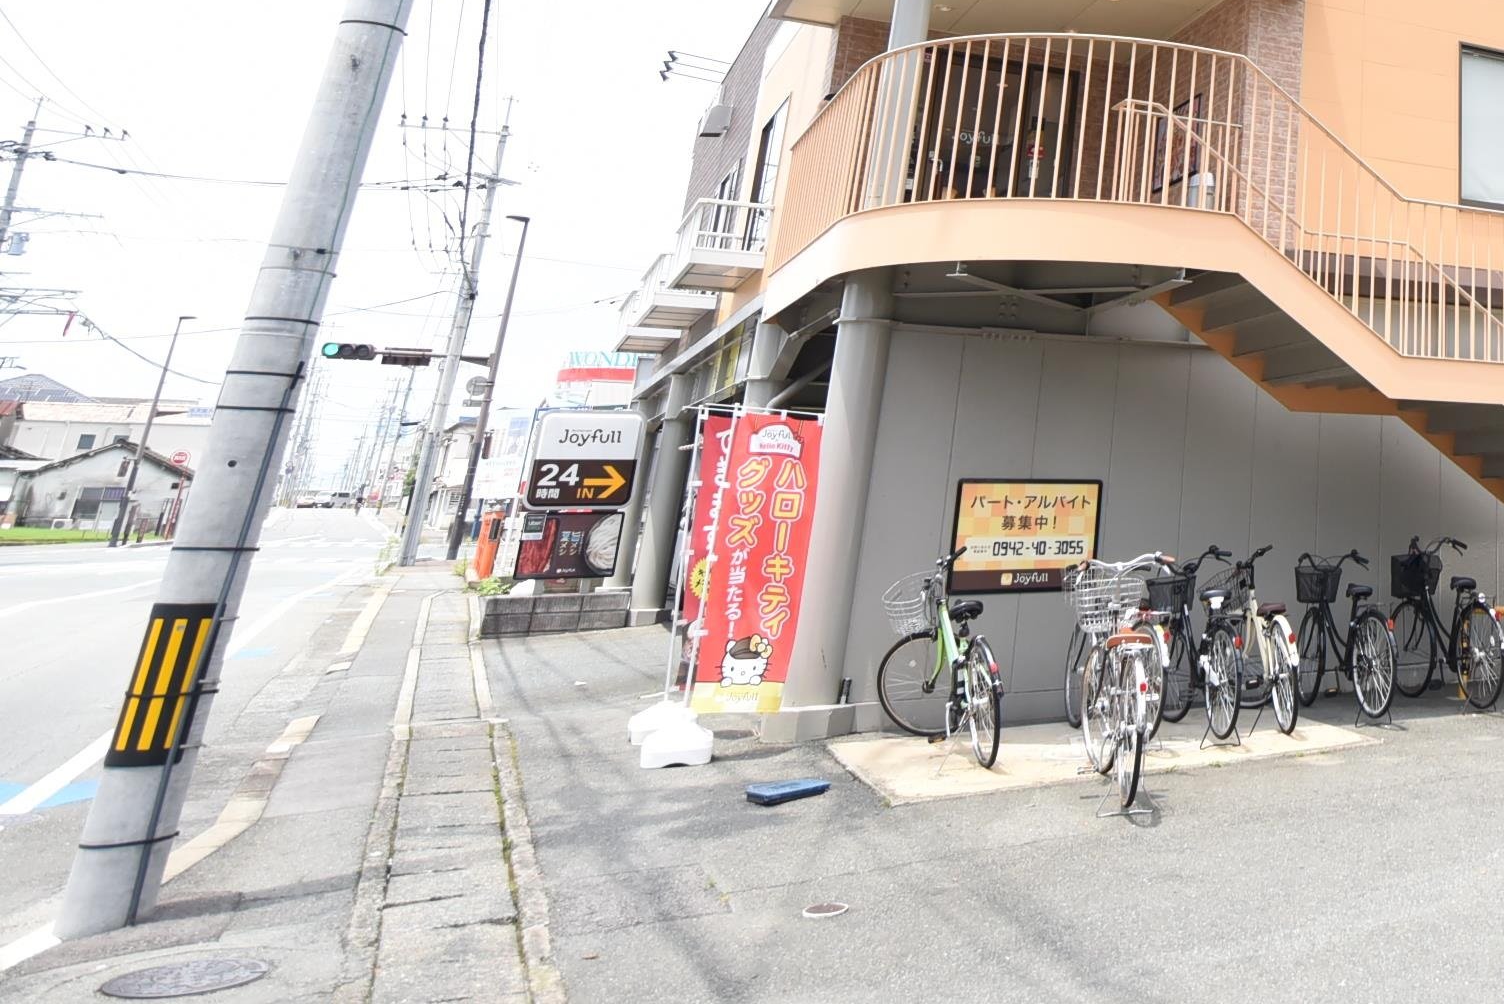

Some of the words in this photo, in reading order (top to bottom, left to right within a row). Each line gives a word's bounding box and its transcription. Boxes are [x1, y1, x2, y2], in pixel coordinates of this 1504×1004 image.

[559, 429, 621, 446] Joyfull
[537, 463, 580, 486] 24
[535, 488, 560, 499] 時間
[576, 488, 595, 499] IN
[758, 458, 808, 639] ハローキティ
[1014, 572, 1048, 585] Joyfull
